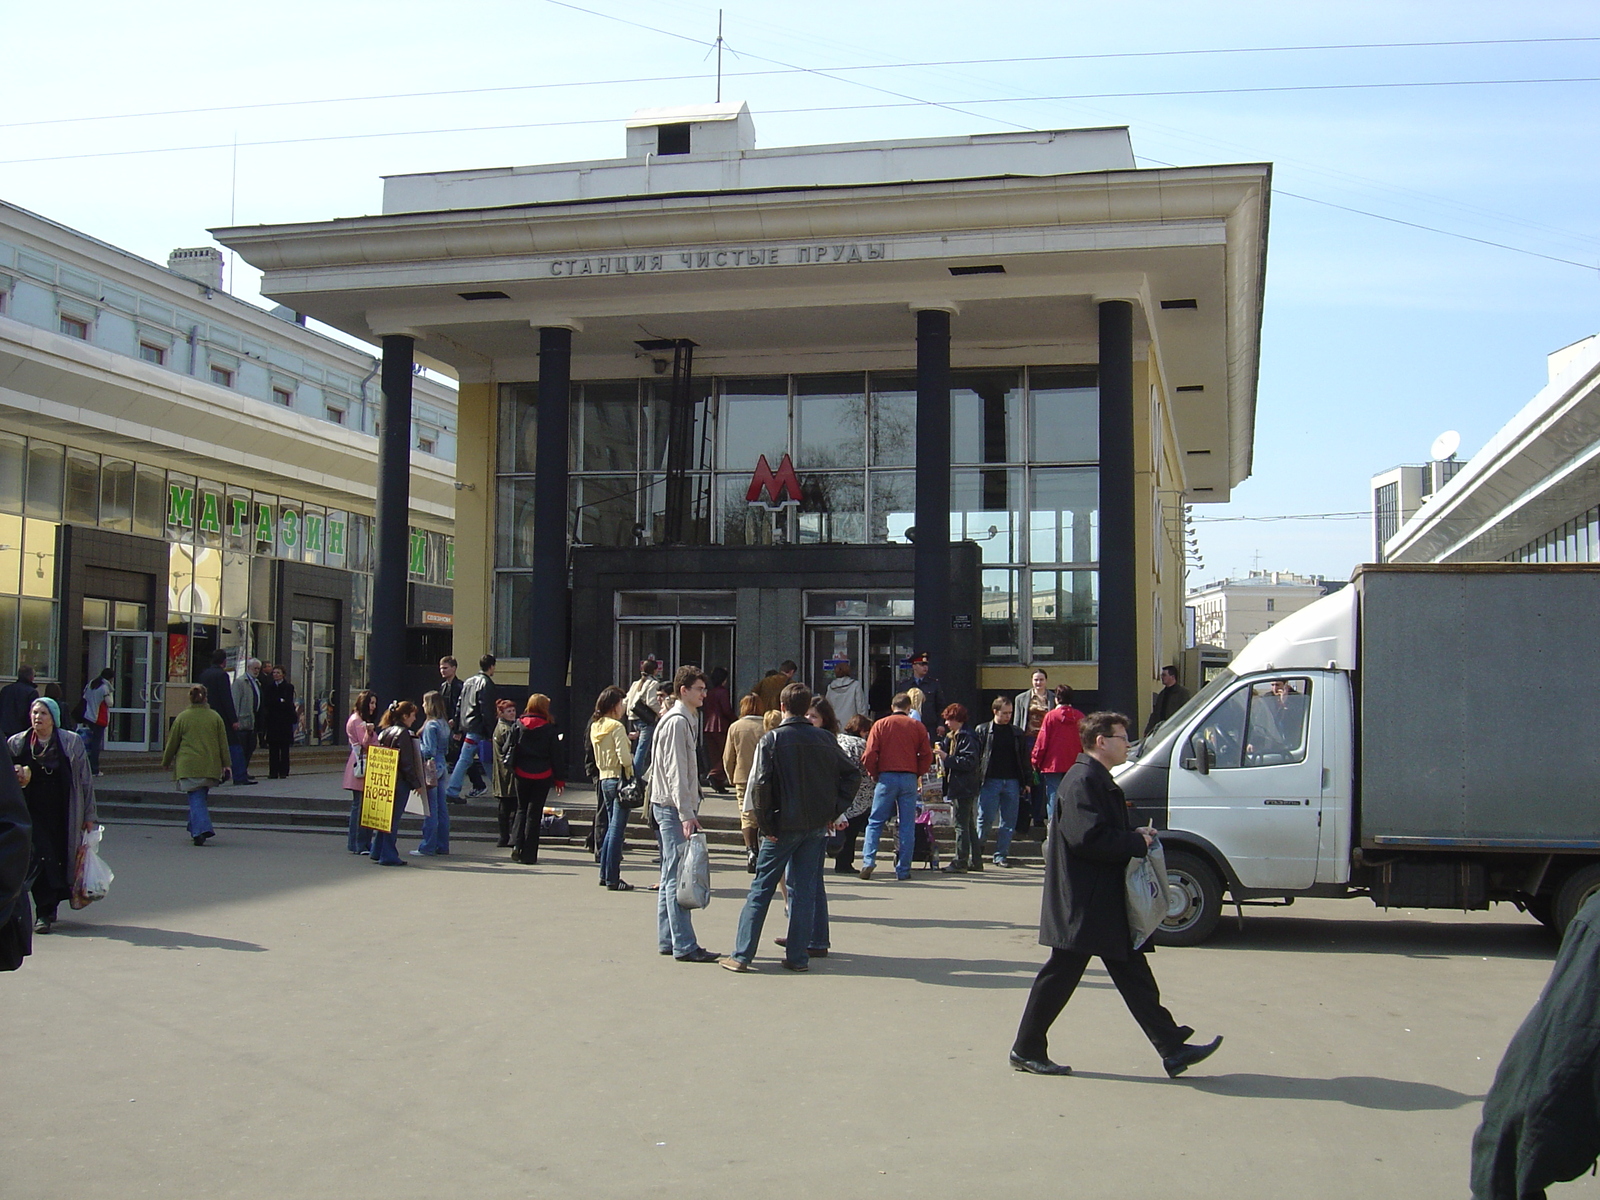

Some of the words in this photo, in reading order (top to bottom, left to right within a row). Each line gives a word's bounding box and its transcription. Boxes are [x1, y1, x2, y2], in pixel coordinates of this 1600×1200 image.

[550, 254, 663, 276] СТАНЦИЯ
[681, 248, 779, 269] ЧИСТЫЕ
[797, 243, 885, 264] ПРУДЫ
[168, 484, 344, 556] МАГАЗИН
[371, 772, 391, 787] ЧАЙ
